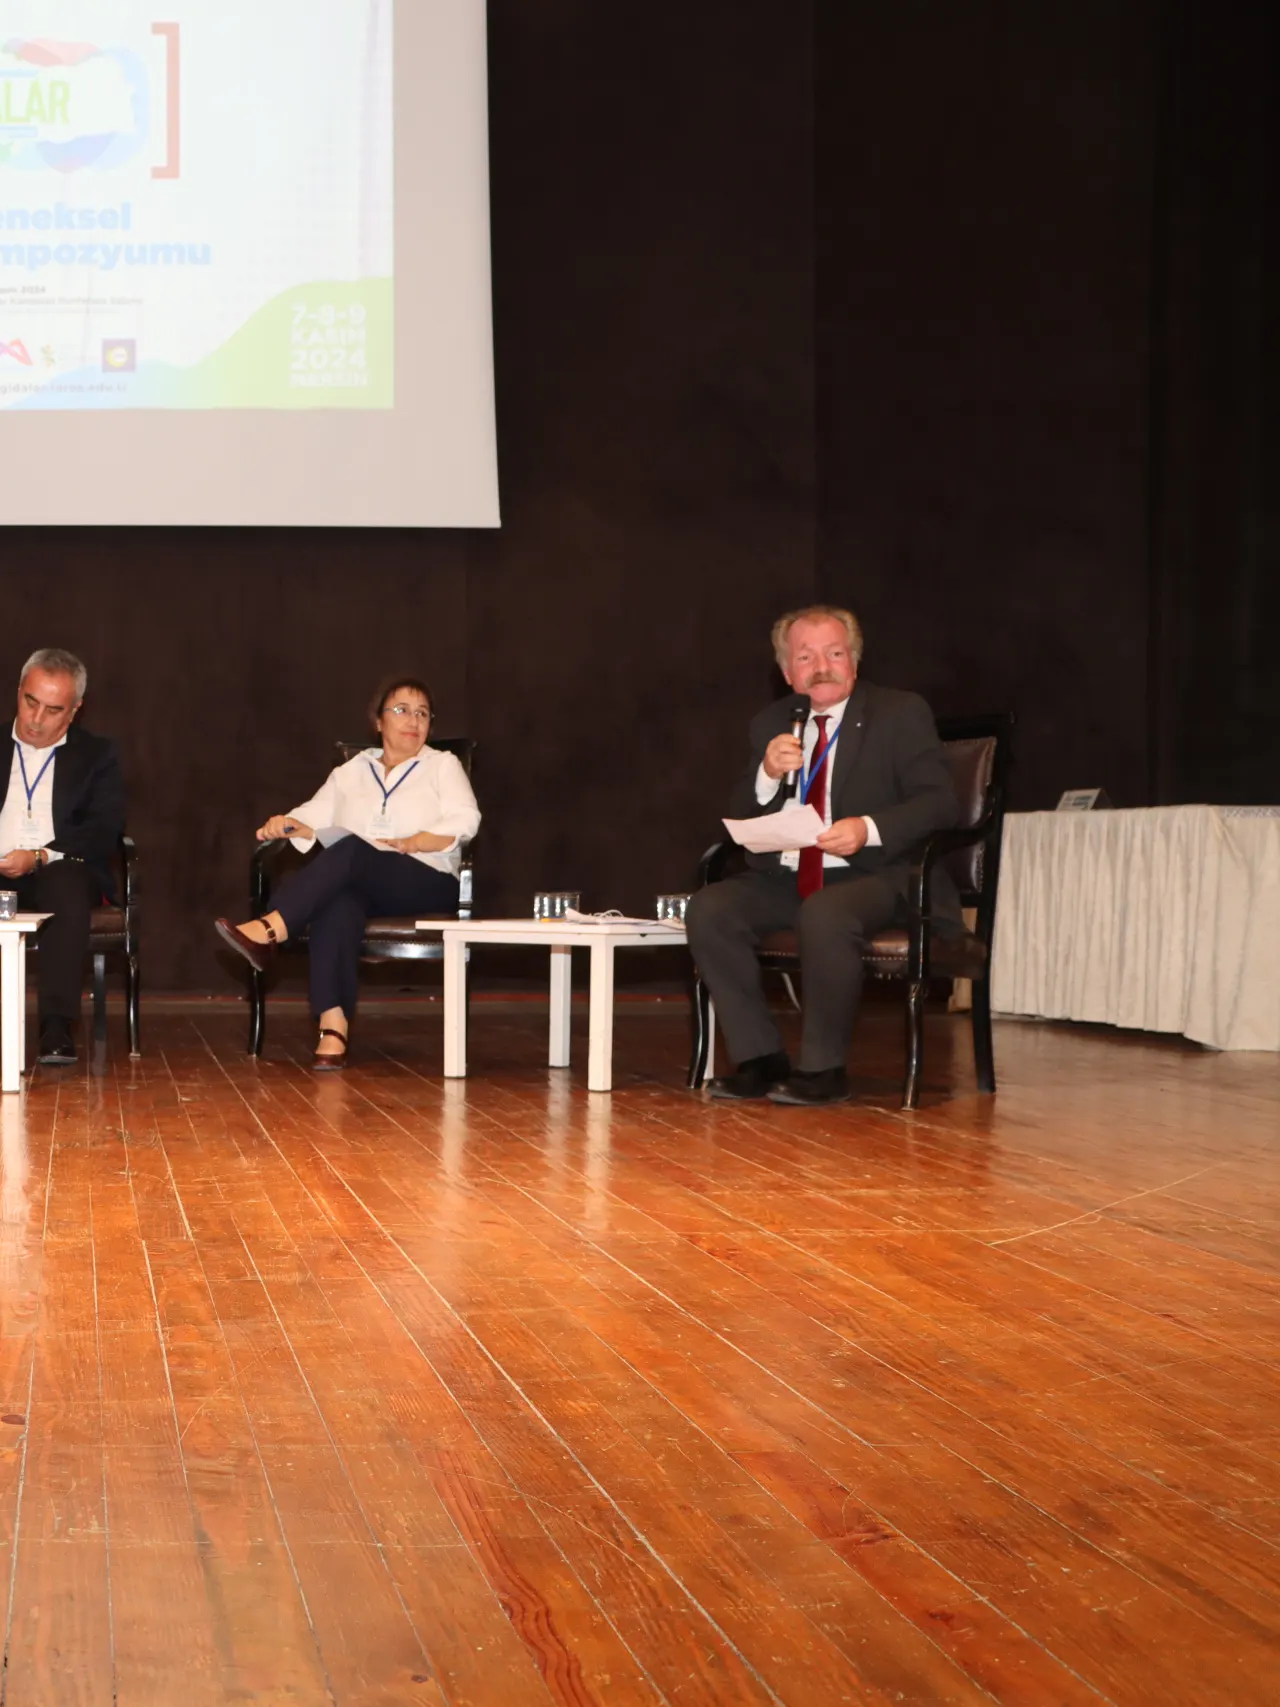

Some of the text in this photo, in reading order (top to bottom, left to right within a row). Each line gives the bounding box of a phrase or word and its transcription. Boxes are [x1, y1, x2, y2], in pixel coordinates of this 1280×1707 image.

[290, 304, 367, 326] 7-8-9
[291, 327, 366, 345] KASIM
[290, 347, 366, 371] 2024
